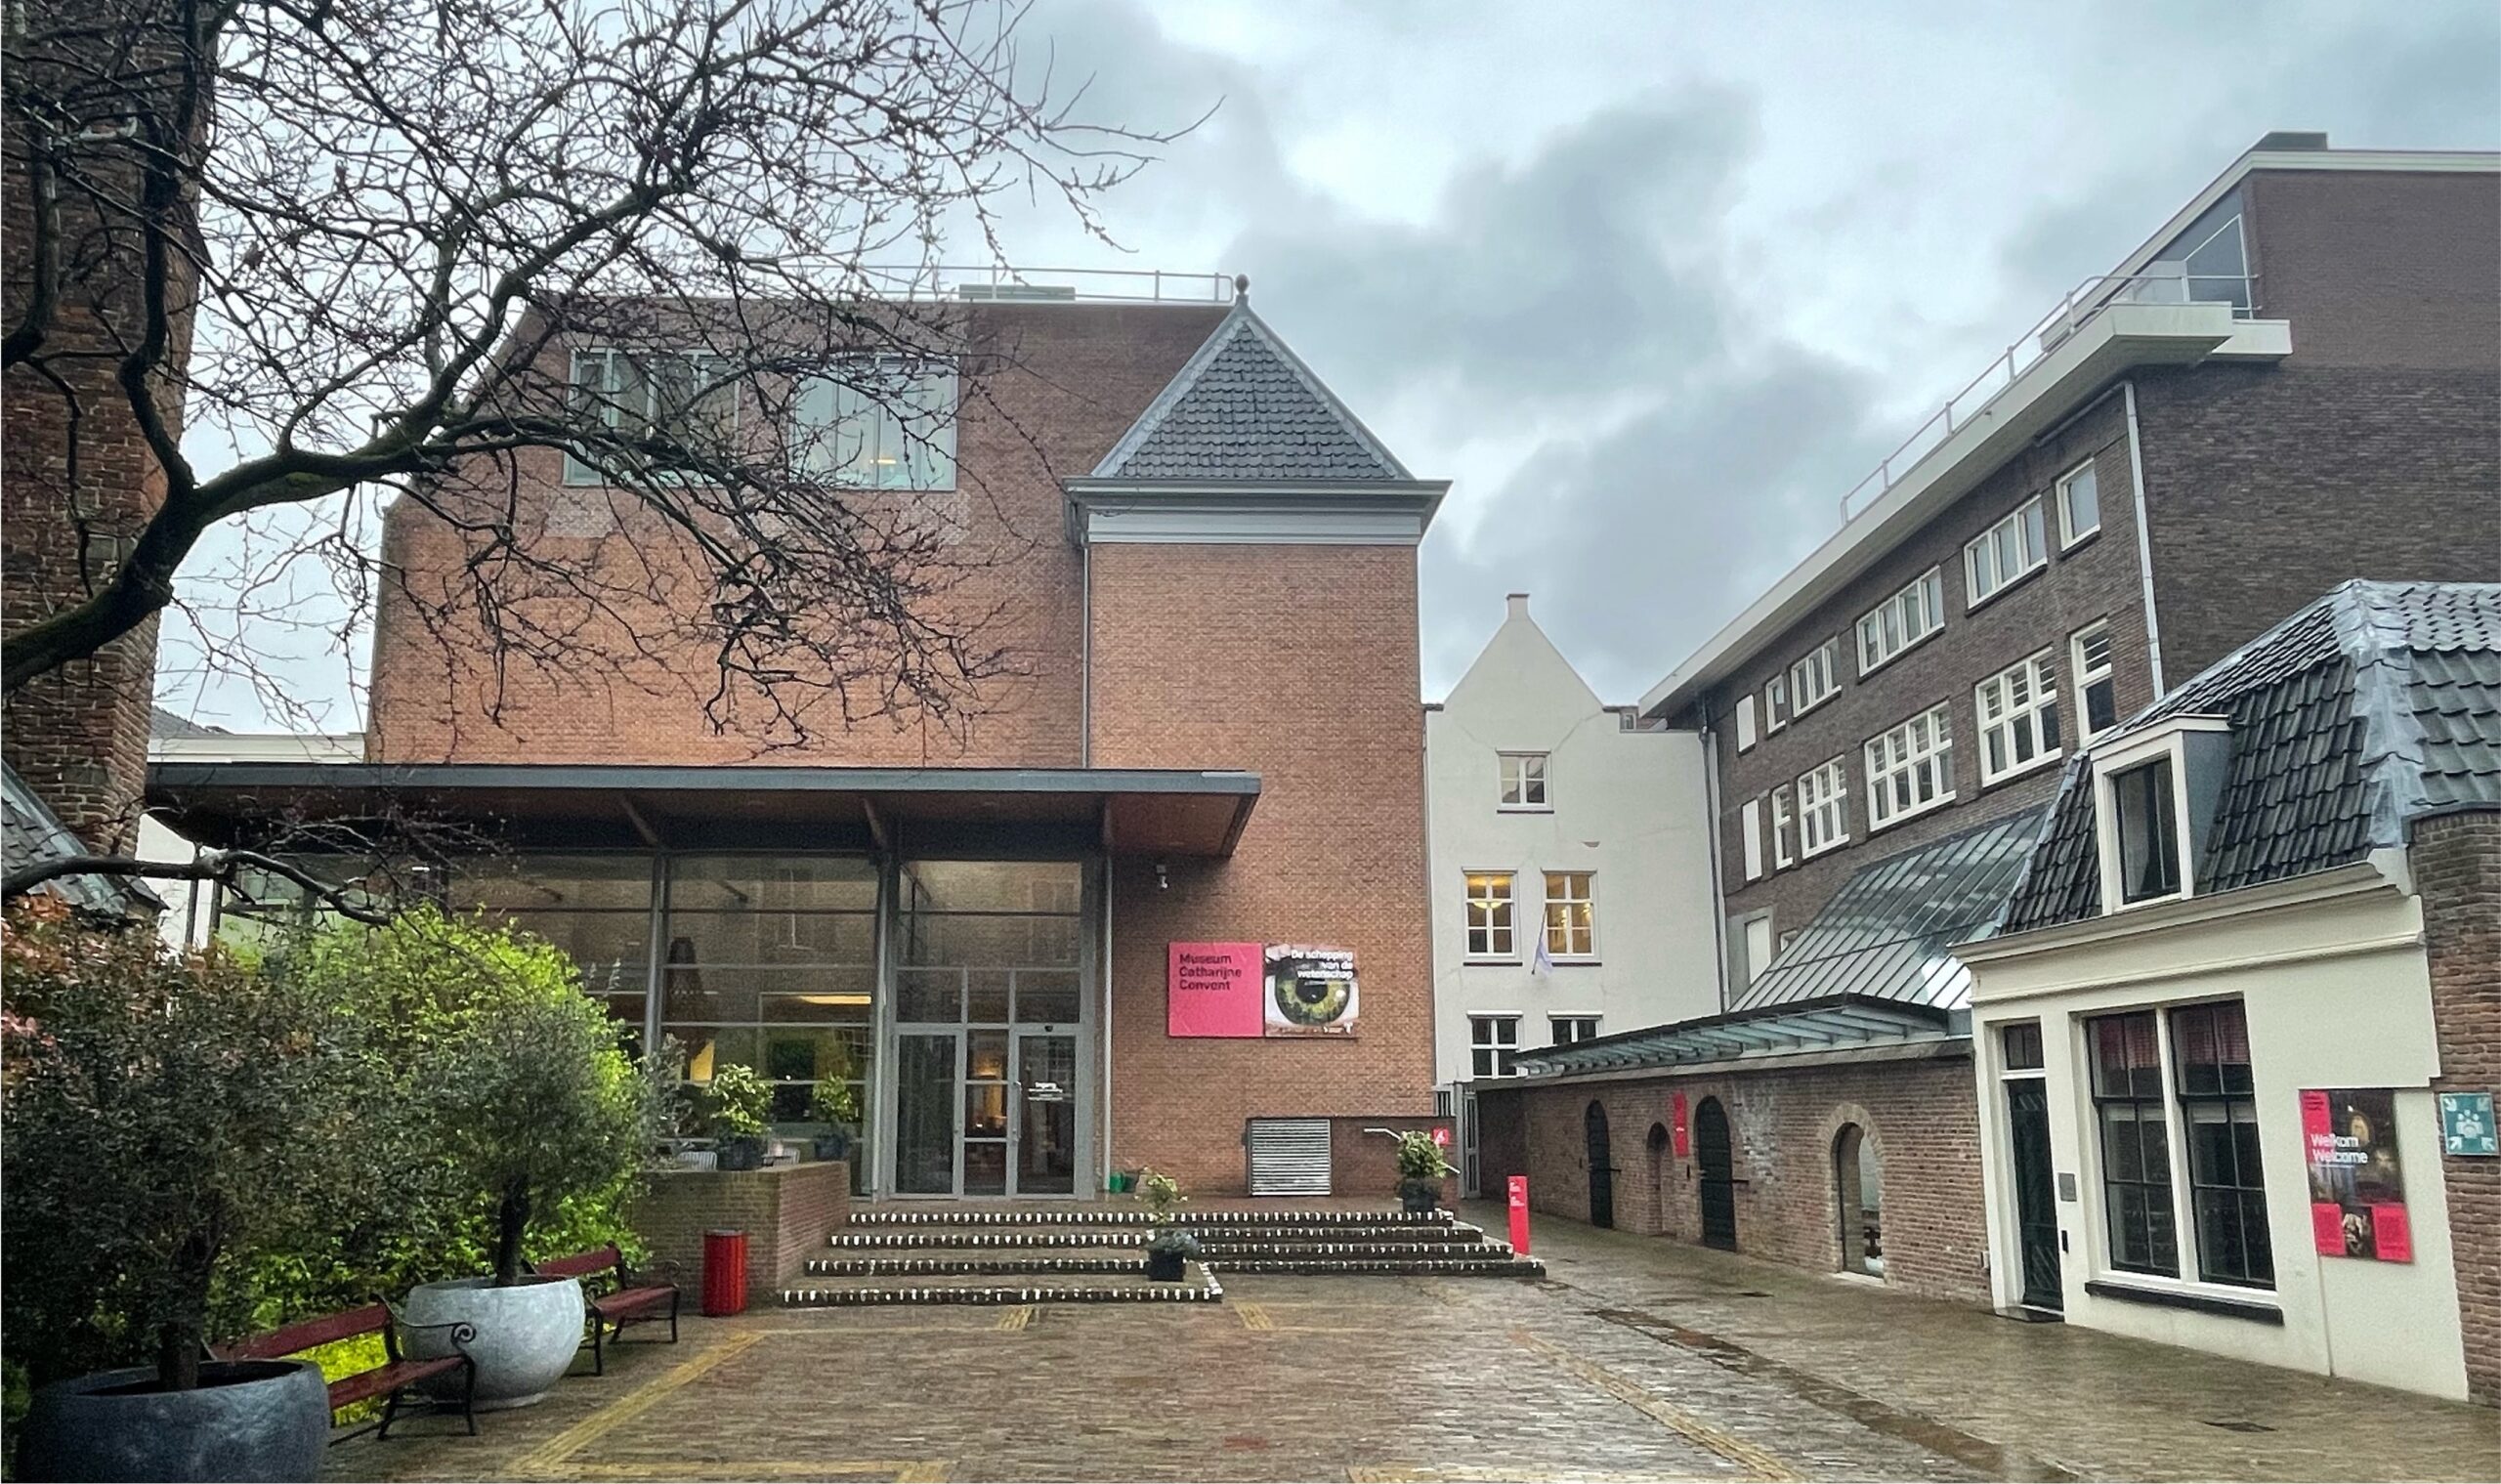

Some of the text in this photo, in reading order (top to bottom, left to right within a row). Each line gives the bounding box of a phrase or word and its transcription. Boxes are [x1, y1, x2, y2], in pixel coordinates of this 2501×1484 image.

[1179, 954, 1232, 964] Museum
[1291, 949, 1353, 960] De schepping
[1179, 966, 1242, 979] Catharijne
[1297, 970, 1353, 979] wetenschap
[1179, 980, 1231, 990] Convent
[2310, 1133, 2359, 1147] Welkom
[2311, 1149, 2368, 1164] Welcome
